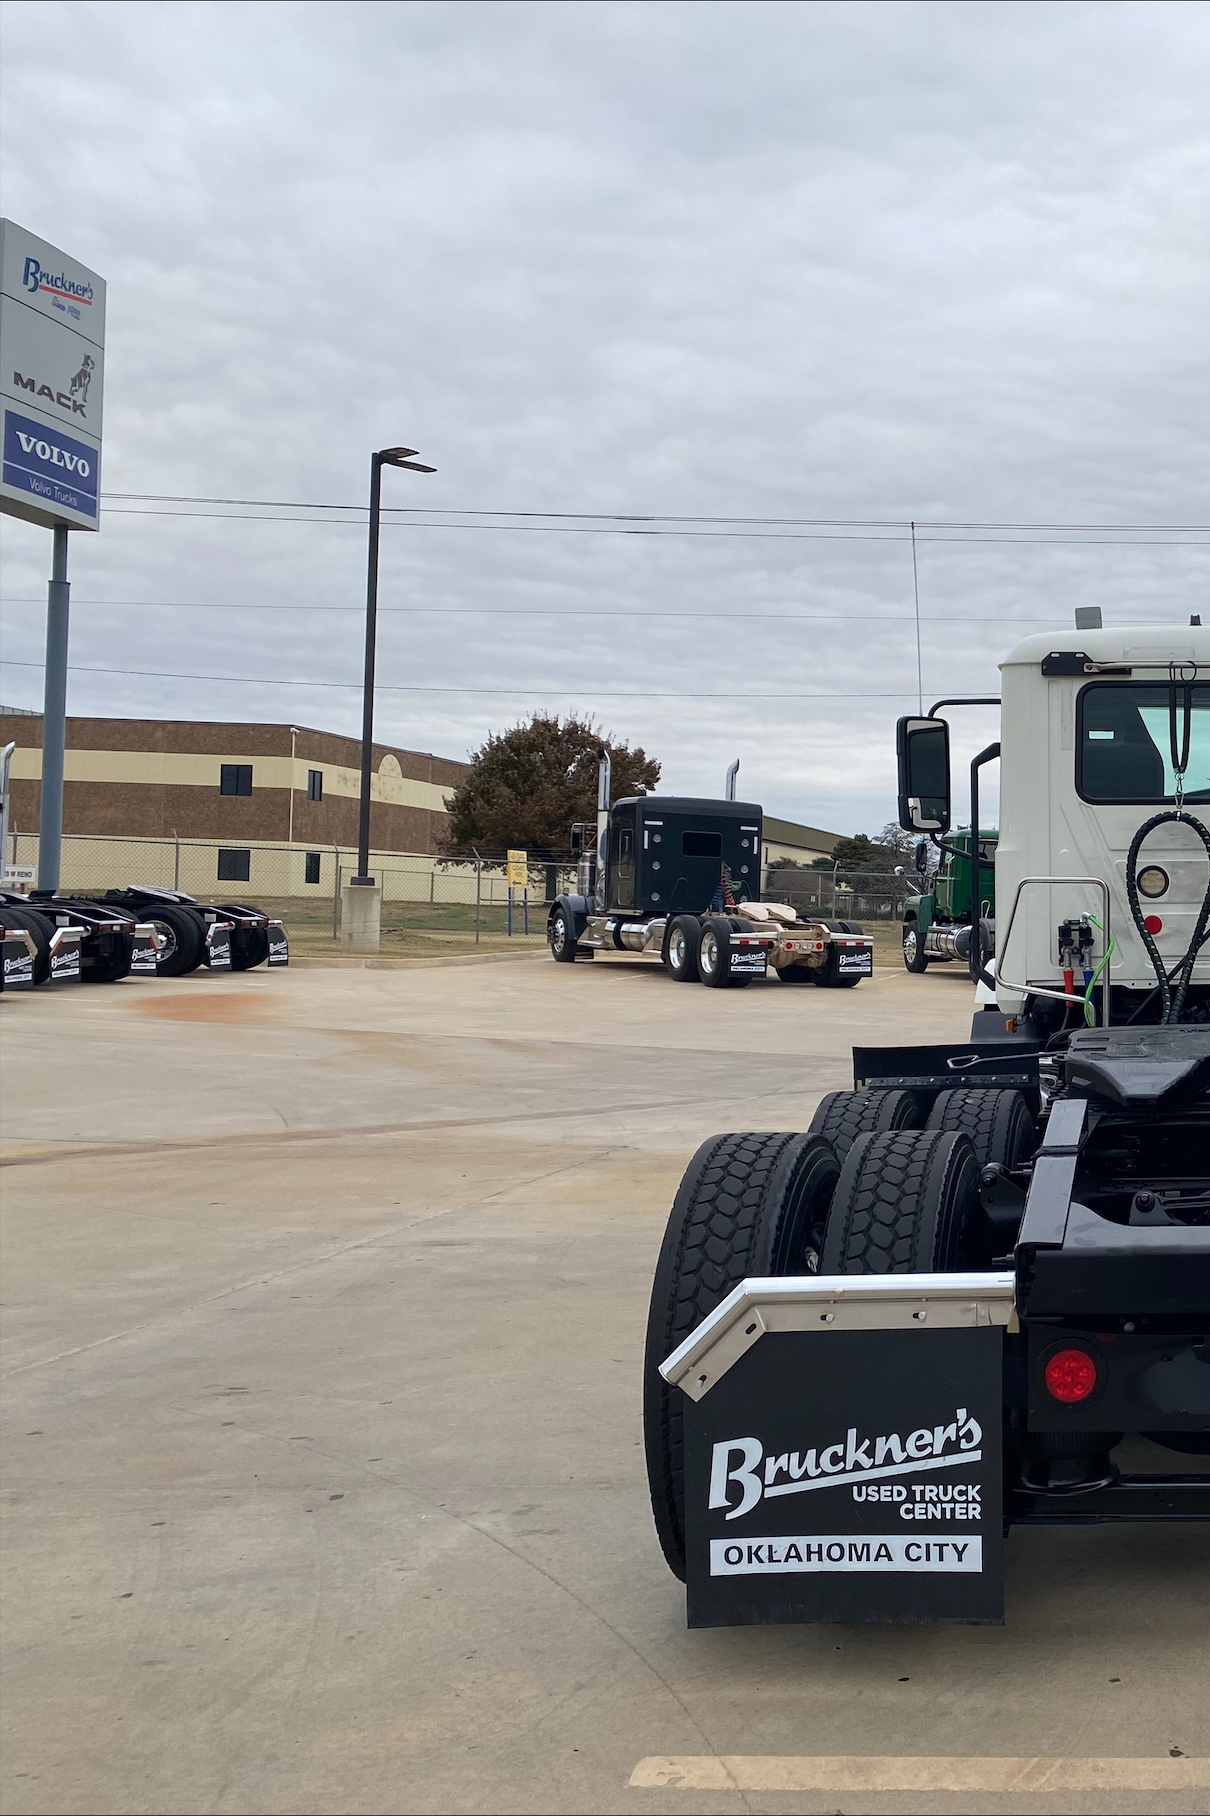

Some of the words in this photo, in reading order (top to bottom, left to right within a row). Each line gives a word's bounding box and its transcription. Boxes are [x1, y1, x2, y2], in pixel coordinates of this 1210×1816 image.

[23, 257, 93, 299] Bruckner's
[13, 371, 87, 418] MACK
[16, 431, 90, 477] VOLVO
[29, 476, 52, 496] Volvo
[53, 486, 78, 506] Trucks
[708, 1408, 983, 1520] Bruckner's
[852, 1486, 907, 1502] USED
[911, 1484, 982, 1501] TRUCK
[900, 1503, 982, 1520] CENTER
[724, 1542, 894, 1566] OKLAHOMA
[904, 1542, 970, 1563] CITY
